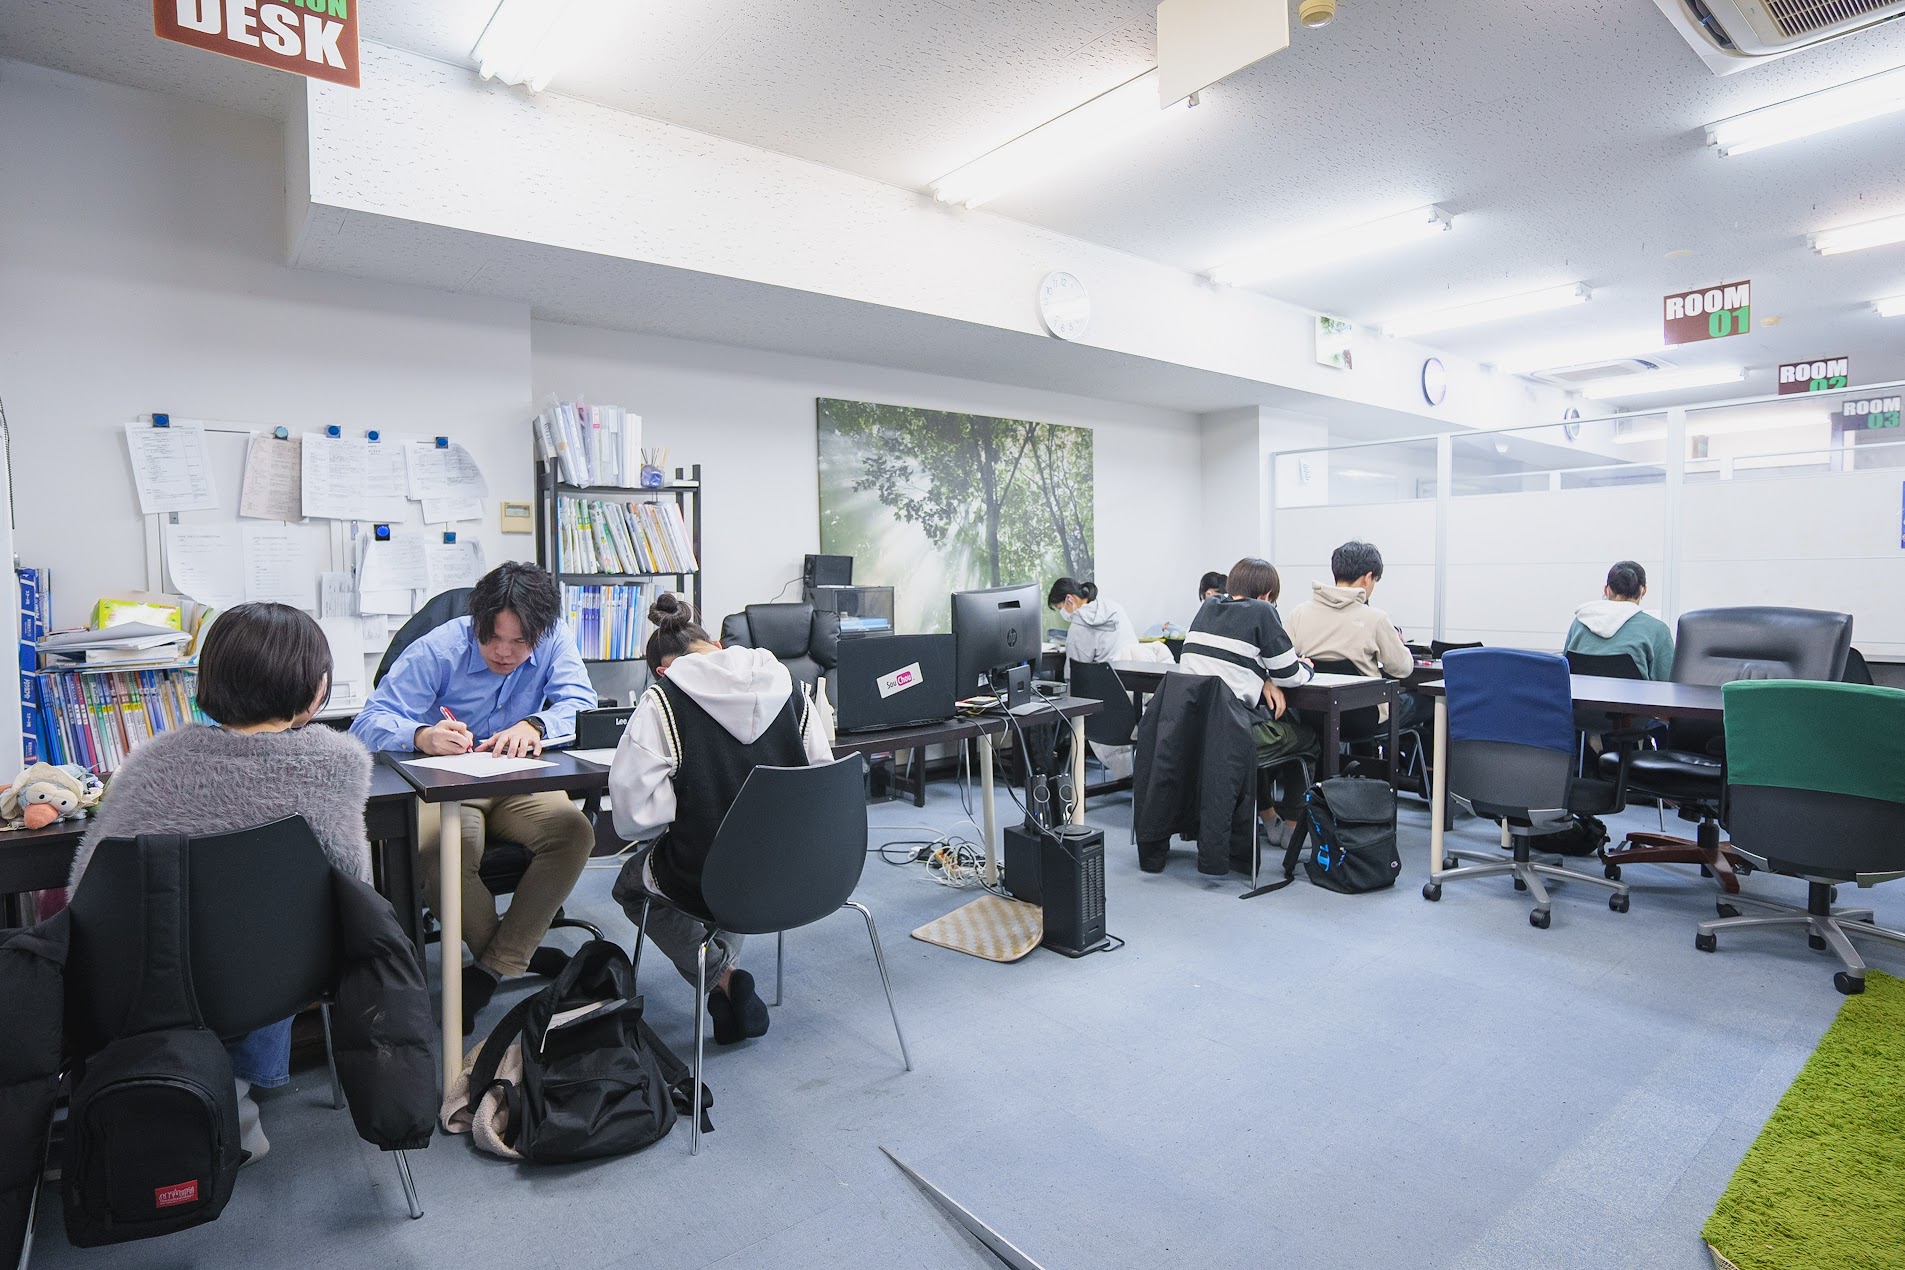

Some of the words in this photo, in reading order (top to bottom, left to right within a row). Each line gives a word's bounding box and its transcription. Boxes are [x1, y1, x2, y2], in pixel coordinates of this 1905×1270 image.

[176, 0, 346, 69] DESK
[1666, 284, 1749, 320] ROOM
[1709, 306, 1749, 337] 01
[1780, 359, 1847, 383] ROOM
[1810, 376, 1847, 392] 02
[1843, 397, 1900, 416] ROOM
[1868, 411, 1900, 429] 03
